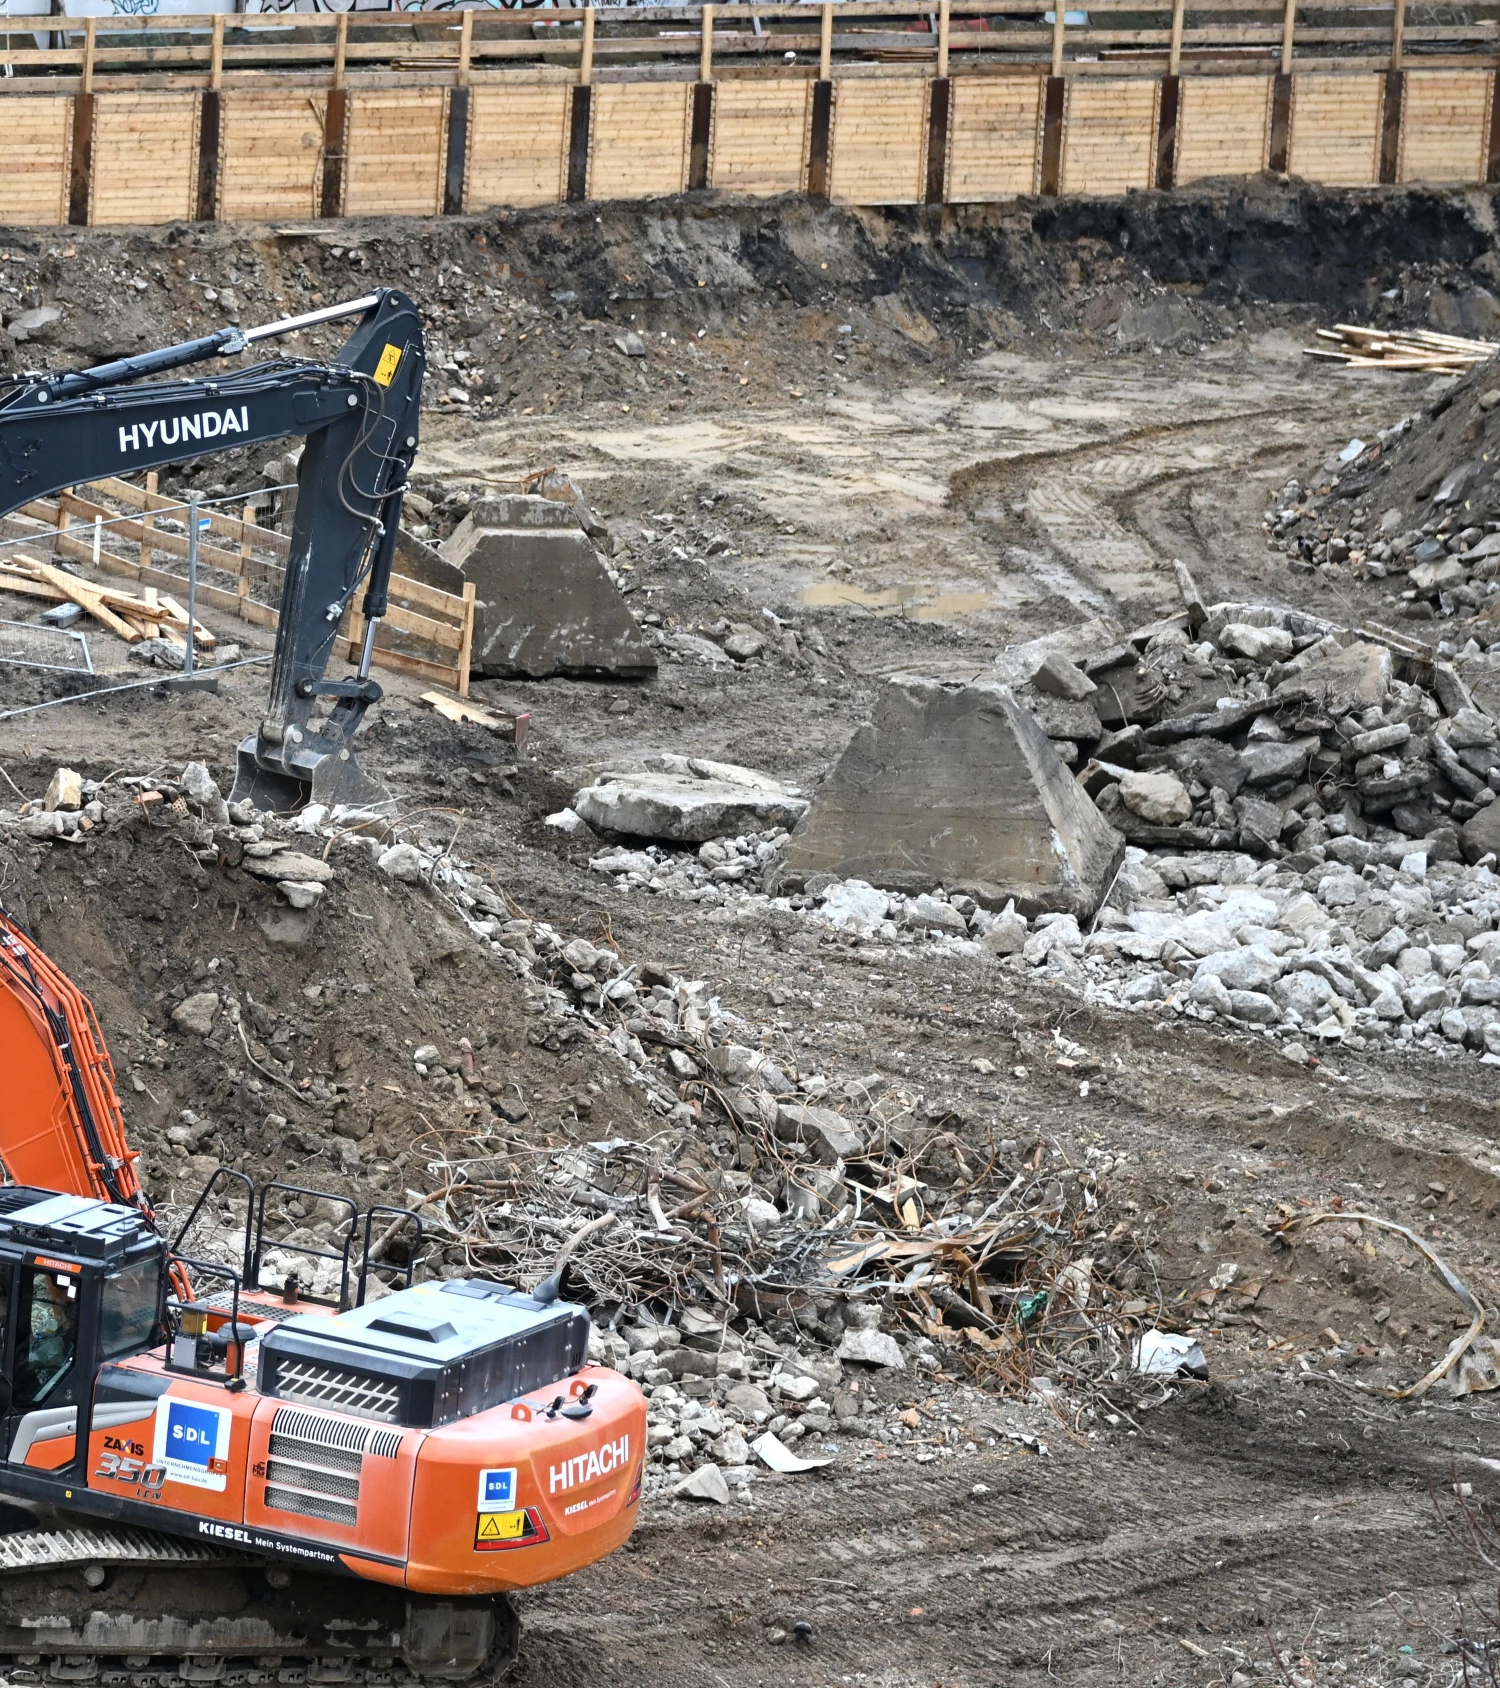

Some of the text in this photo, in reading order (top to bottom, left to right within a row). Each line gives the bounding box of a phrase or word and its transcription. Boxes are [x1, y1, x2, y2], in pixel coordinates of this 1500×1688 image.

[118, 405, 249, 453] HYUNDAI
[43, 1258, 73, 1270] HITACHI
[104, 1436, 145, 1456] ZAXIS
[94, 1452, 167, 1490] 350
[549, 1433, 629, 1494] HITACHI
[136, 1488, 162, 1500] LCN
[564, 1500, 589, 1516] KIESEL
[199, 1521, 336, 1563] KIESEL Mein Systempartner.
